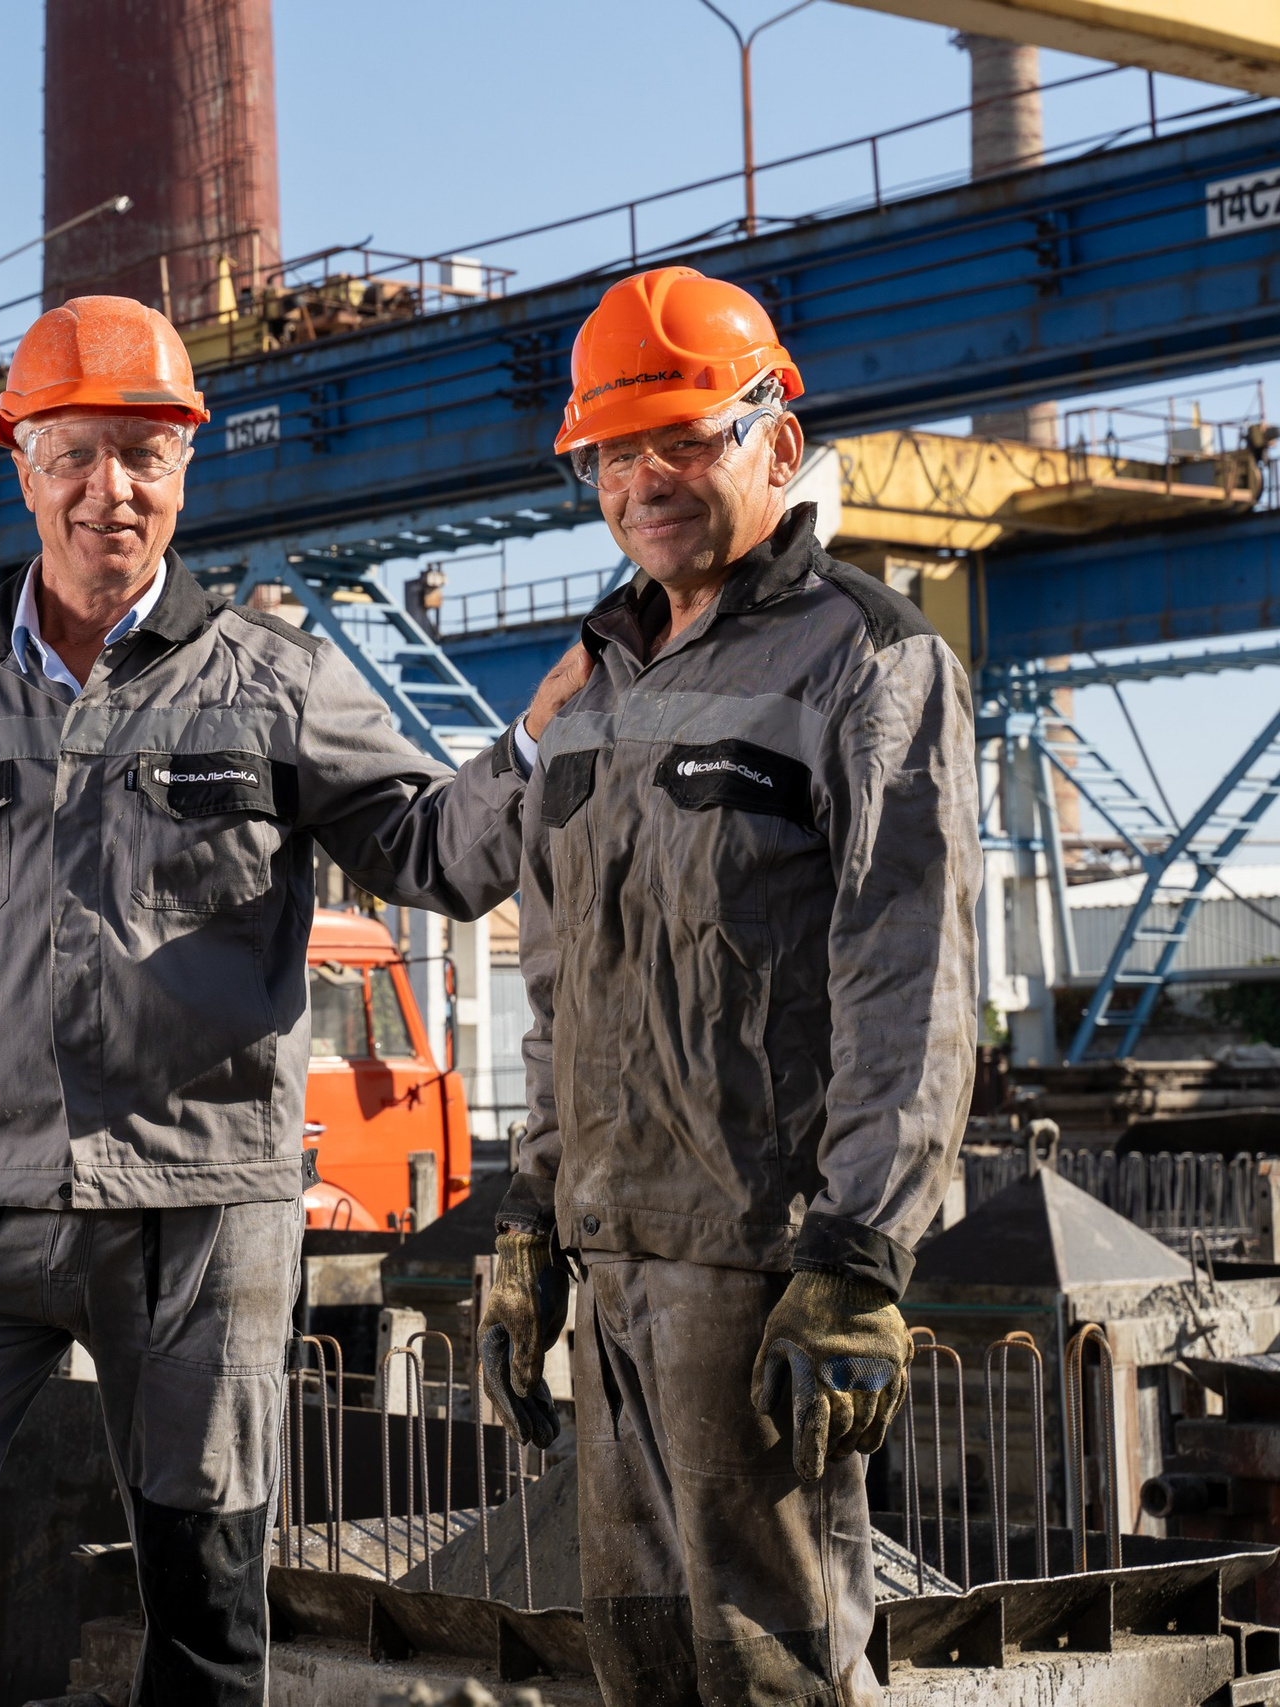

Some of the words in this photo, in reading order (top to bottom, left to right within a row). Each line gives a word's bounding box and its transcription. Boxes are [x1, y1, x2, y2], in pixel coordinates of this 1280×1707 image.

[581, 370, 684, 404] КОВАЛЬСЬКА
[170, 769, 258, 784] КОВАЛЬСЬКА
[693, 760, 773, 788] КОВАЛЬСЬКА
